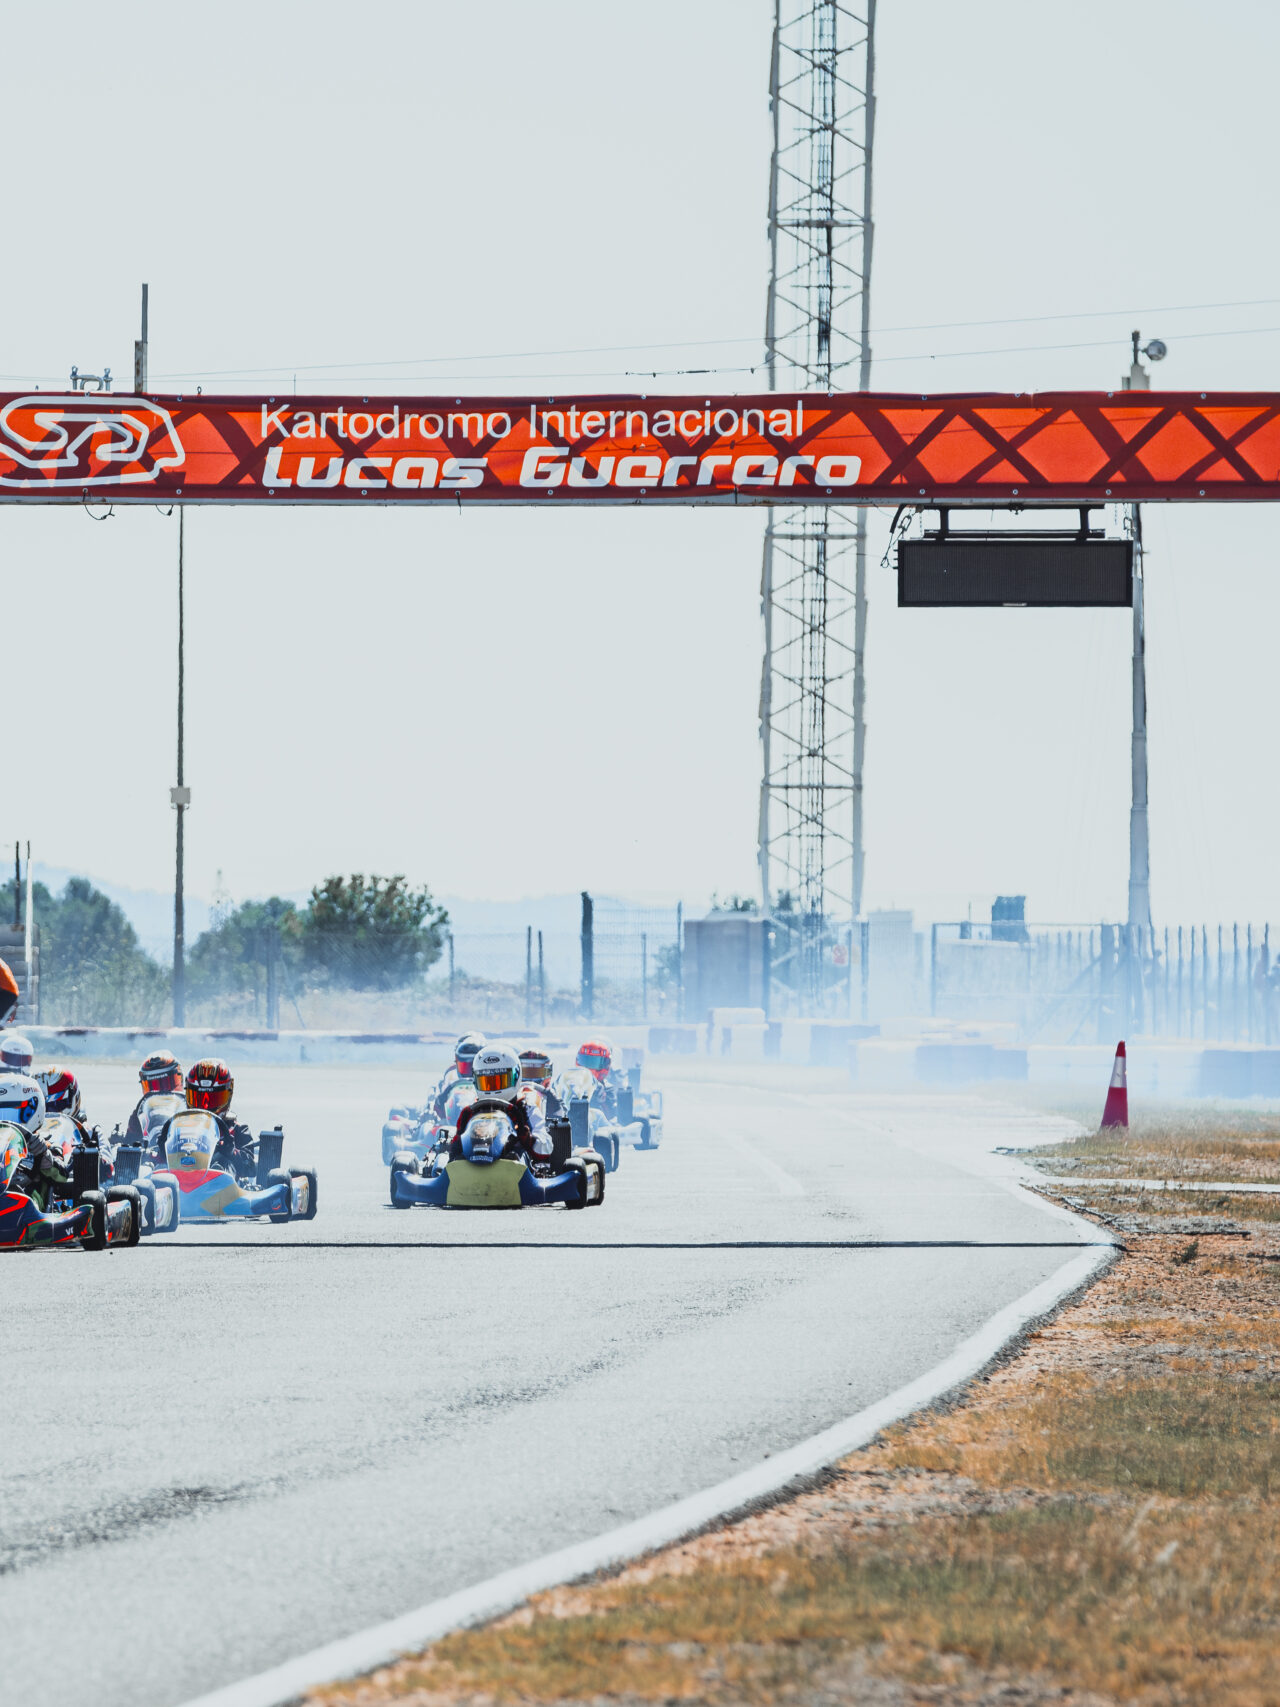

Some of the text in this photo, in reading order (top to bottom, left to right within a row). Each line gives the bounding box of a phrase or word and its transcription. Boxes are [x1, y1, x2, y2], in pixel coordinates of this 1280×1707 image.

[261, 400, 803, 439] Kartodromo Internacional
[262, 446, 862, 489] Lucas Guerrero
